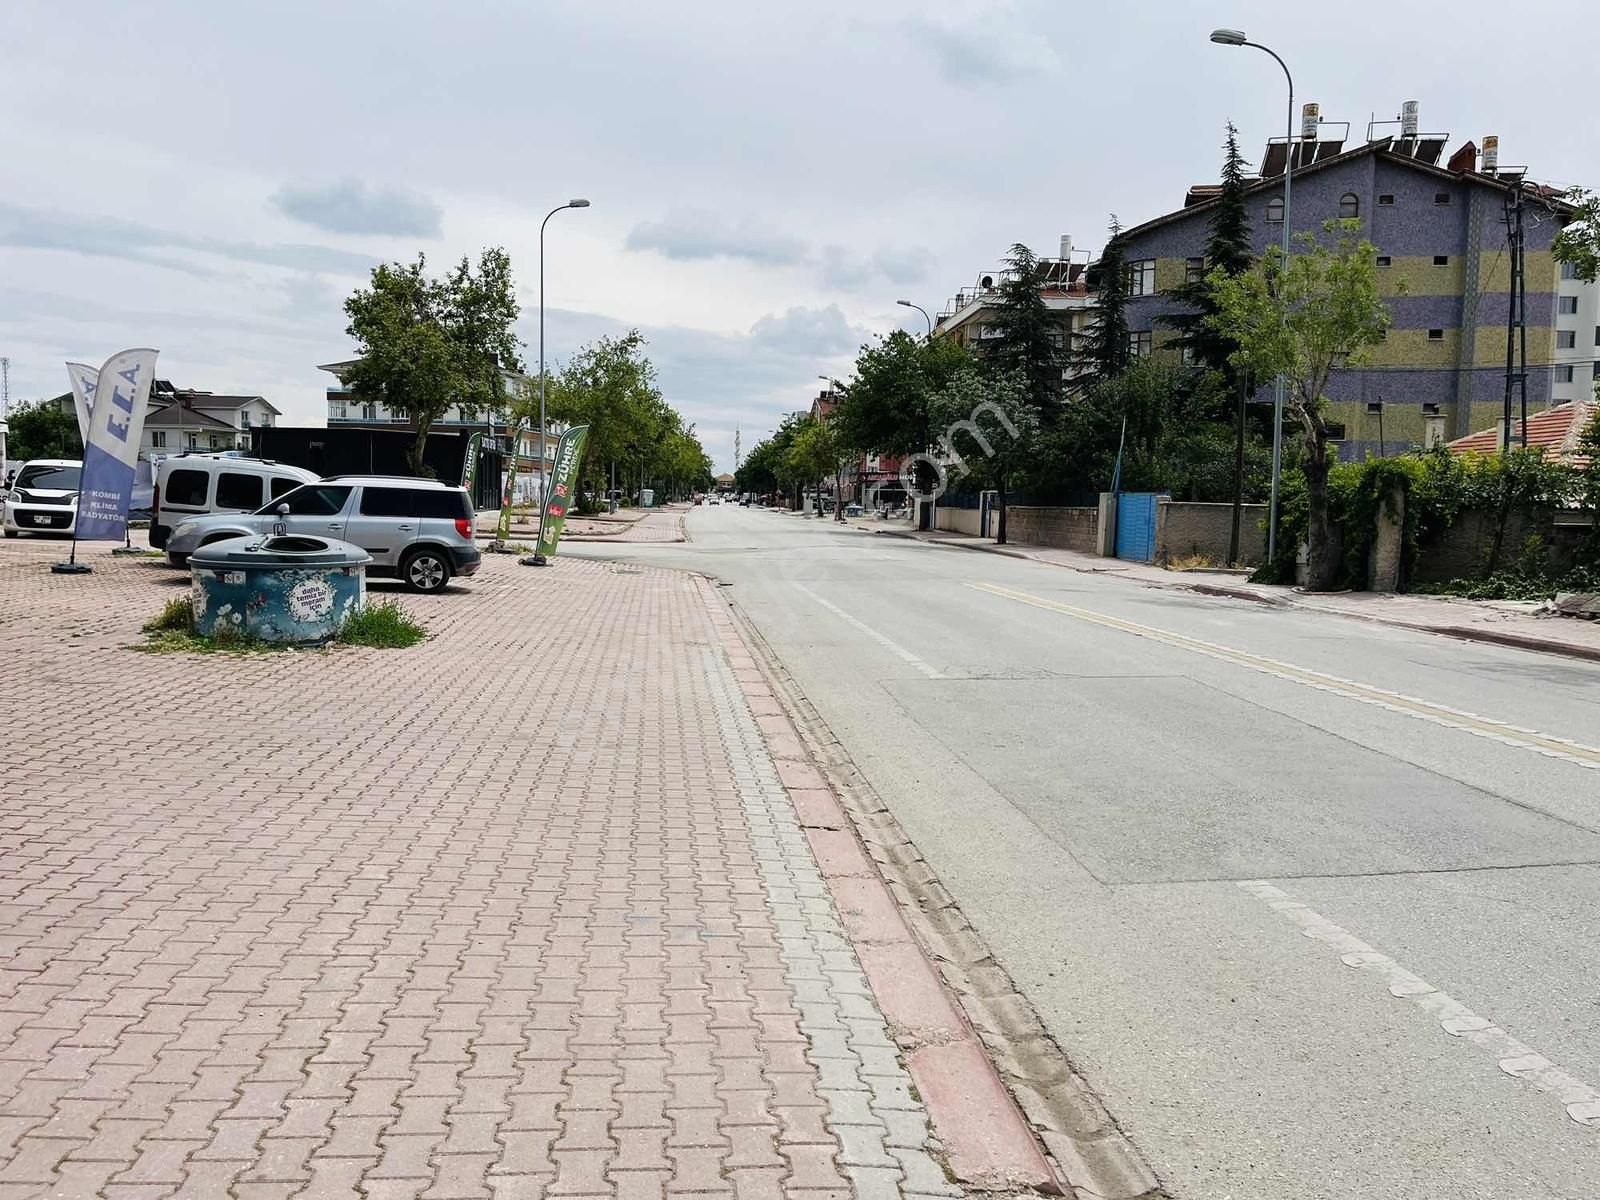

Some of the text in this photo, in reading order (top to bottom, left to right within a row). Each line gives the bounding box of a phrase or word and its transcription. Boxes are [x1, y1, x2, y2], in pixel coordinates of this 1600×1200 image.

[557, 438, 576, 482] ZÜHRE
[302, 587, 320, 595] daha
[296, 593, 317, 602] temiz
